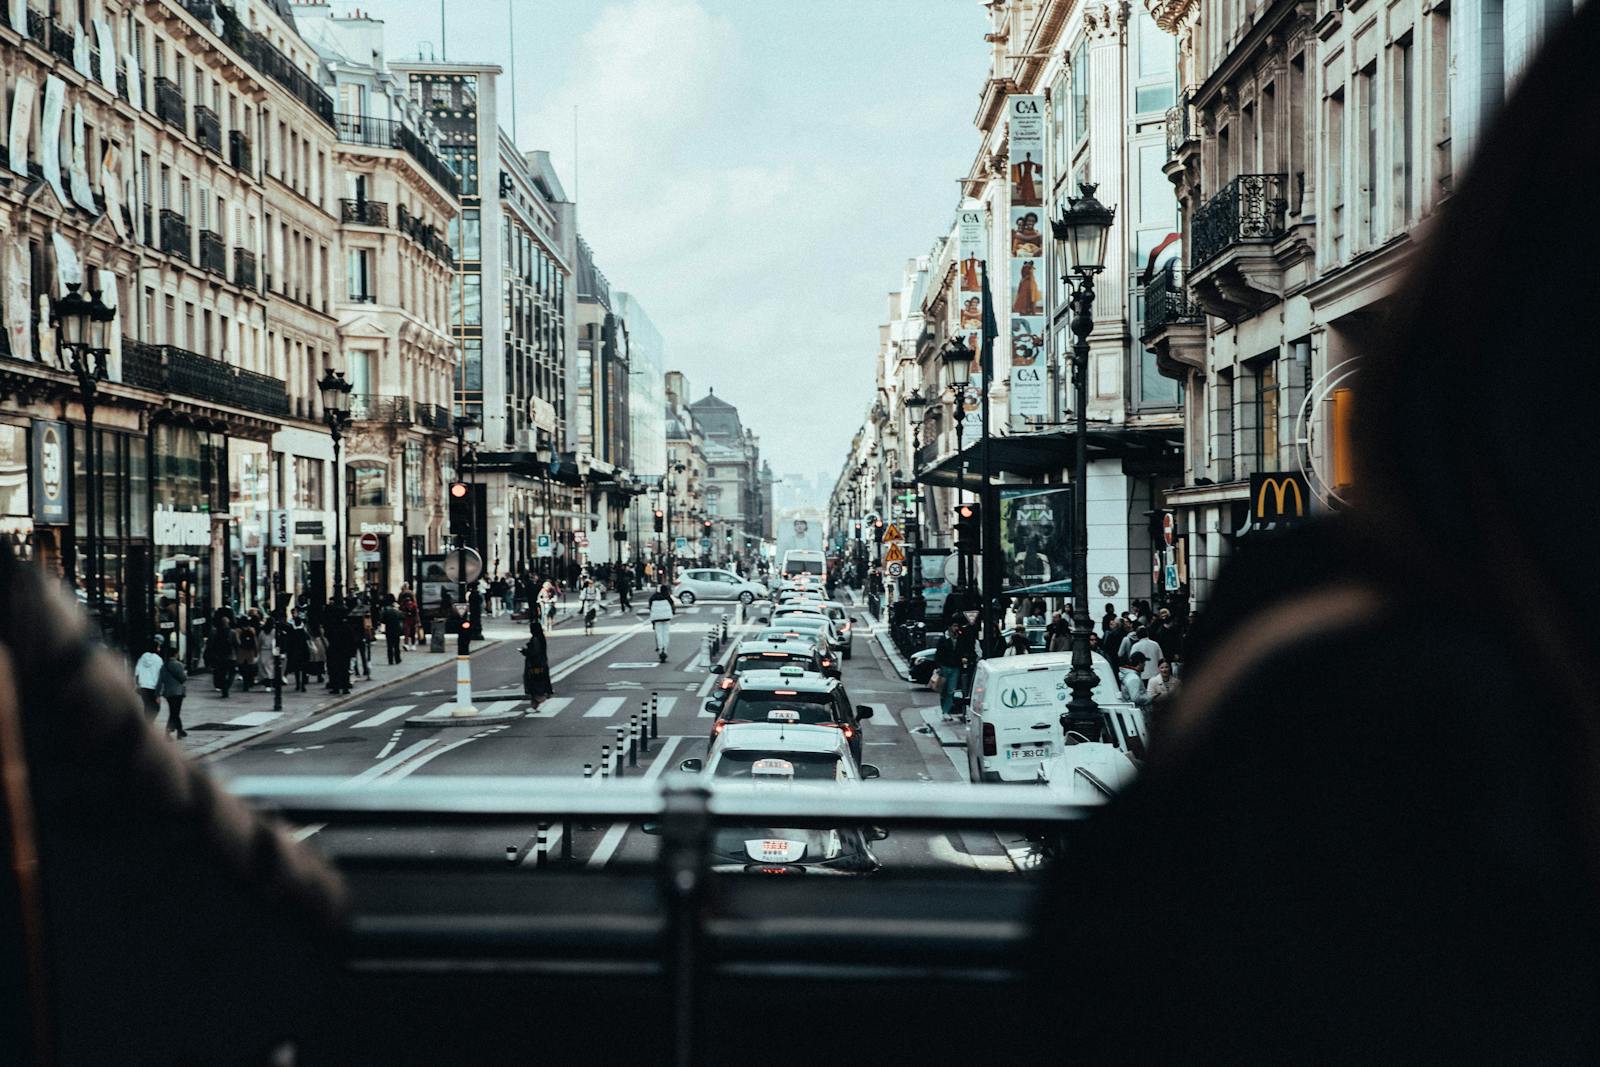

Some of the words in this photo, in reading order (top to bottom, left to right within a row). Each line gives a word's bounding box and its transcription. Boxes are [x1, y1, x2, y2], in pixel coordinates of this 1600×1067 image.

[1015, 100, 1039, 114] C&A
[962, 213, 979, 223] C&A
[1017, 369, 1040, 382] C&A
